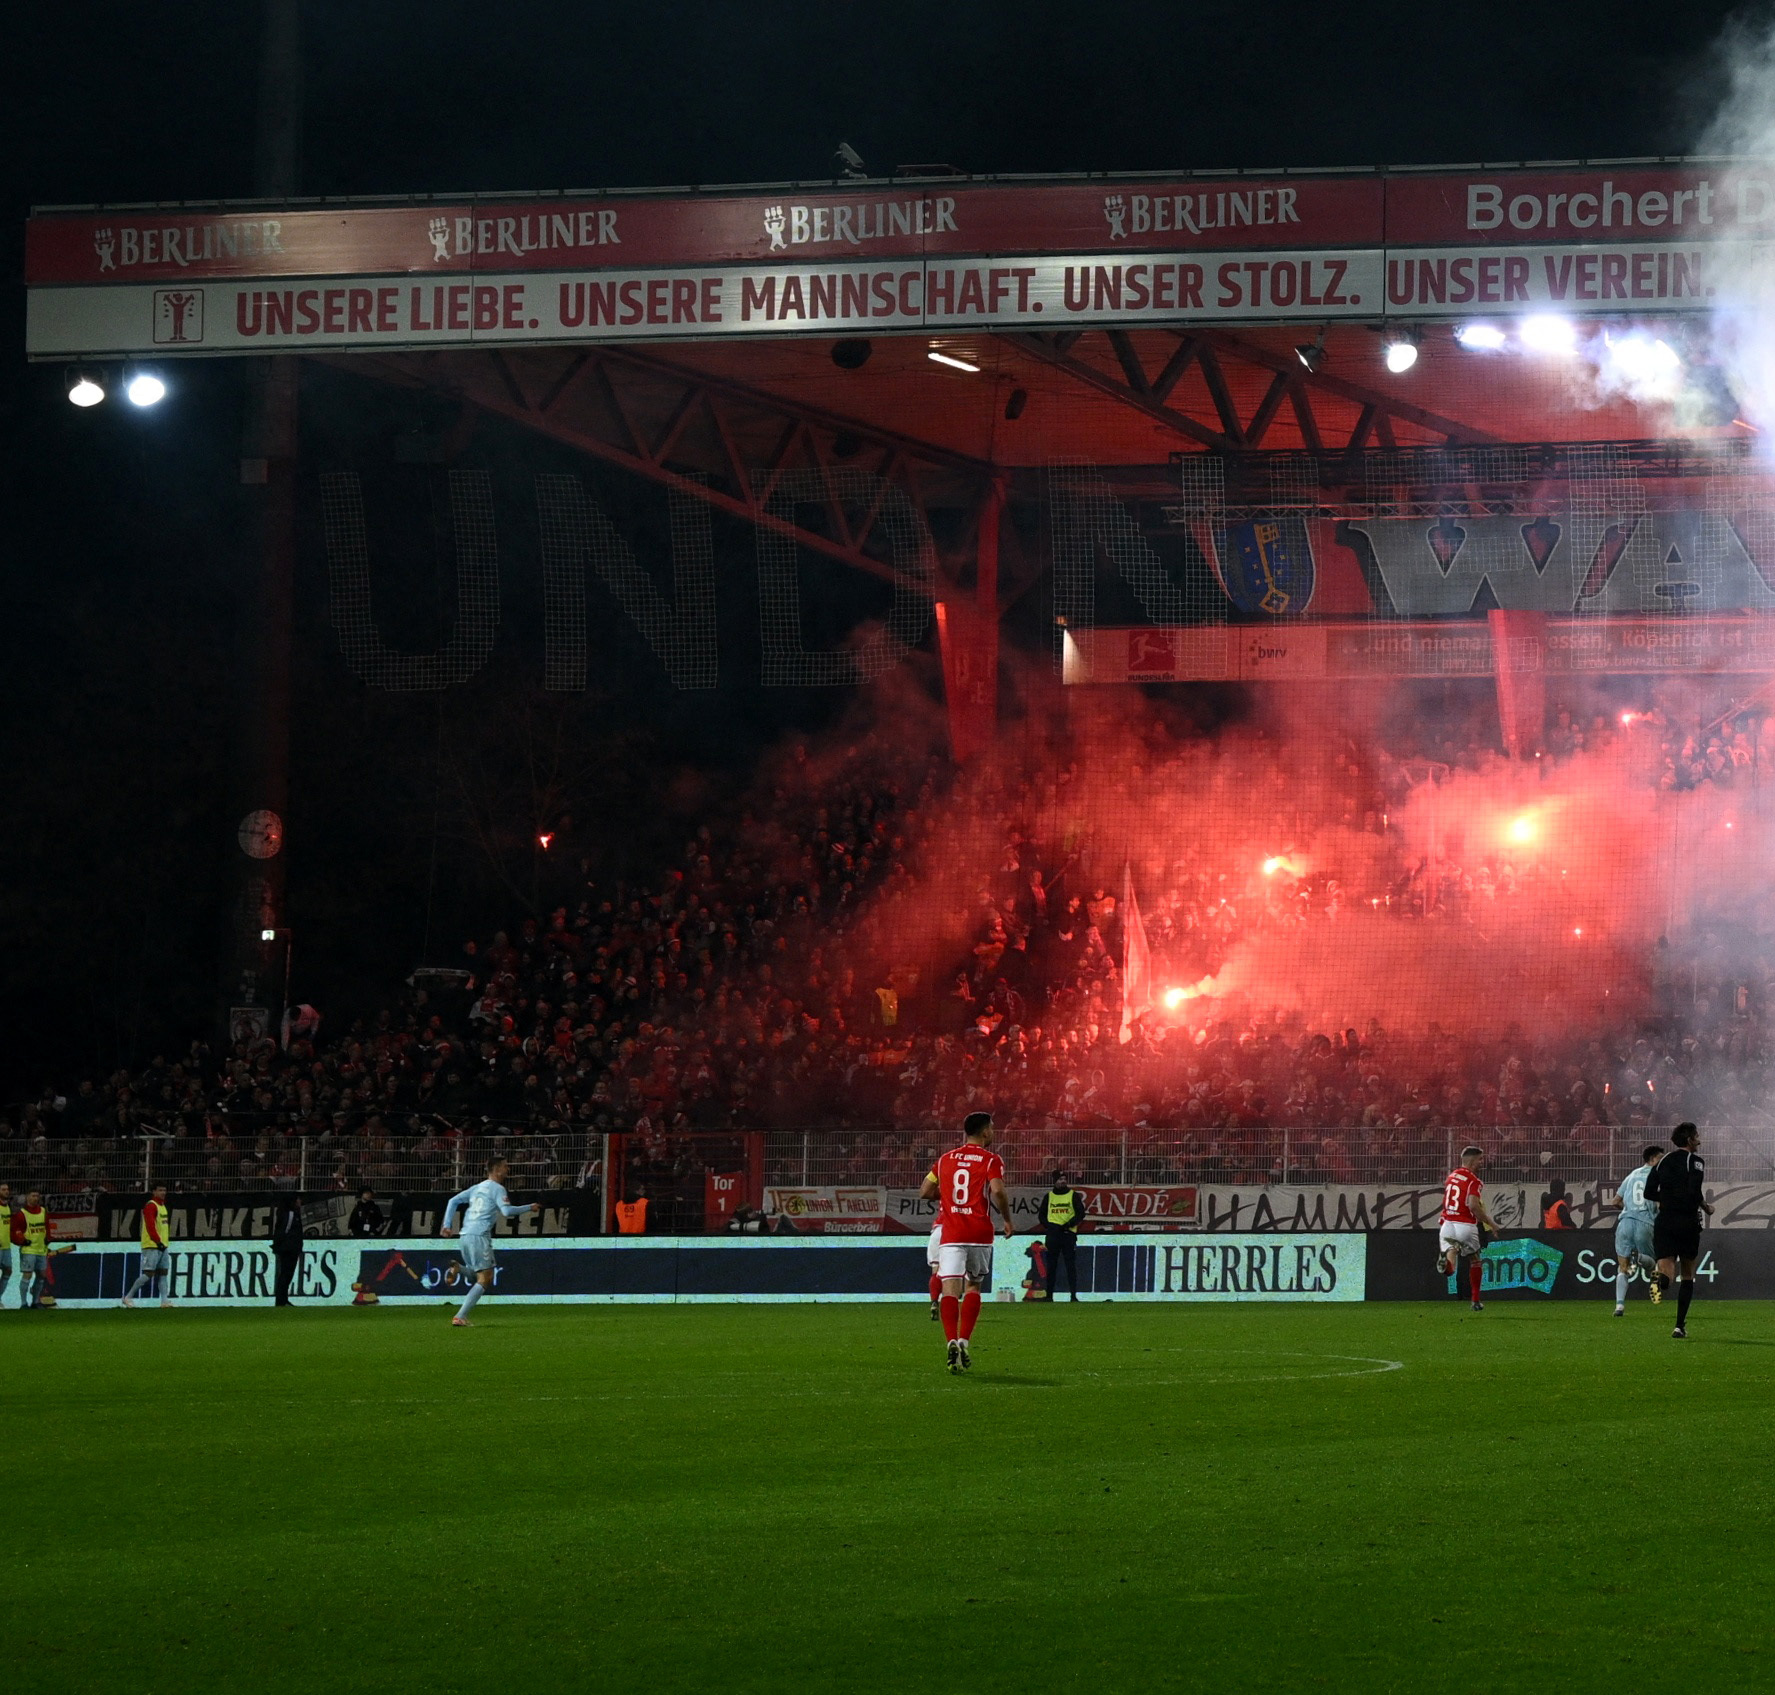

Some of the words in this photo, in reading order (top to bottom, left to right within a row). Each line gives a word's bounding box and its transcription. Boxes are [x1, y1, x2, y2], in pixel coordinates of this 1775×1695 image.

[789, 197, 960, 245] BERLINER
[1130, 187, 1301, 236] BERLINER
[1465, 180, 1716, 231] Borchert
[120, 220, 285, 267] BERLINER
[454, 209, 622, 257] BERLINER
[235, 287, 399, 337] UNSERE
[410, 284, 540, 334] LIEBE.
[558, 276, 724, 328] UNSERE
[740, 267, 1044, 322] MANNSCHAFT.
[1063, 261, 1205, 313] UNSER
[1217, 259, 1361, 309] STOLZ.
[1387, 255, 1532, 305] UNSER
[1542, 251, 1718, 302] VEREIN.
[1257, 645, 1288, 660] bwv
[712, 1175, 735, 1191] Tor
[717, 1198, 726, 1212] 1
[952, 1168, 970, 1206] 8
[1444, 1183, 1460, 1211] 13
[1632, 1180, 1645, 1206] 6
[823, 1220, 880, 1233] Bürgerbräu
[1160, 1243, 1338, 1294] HERRLES
